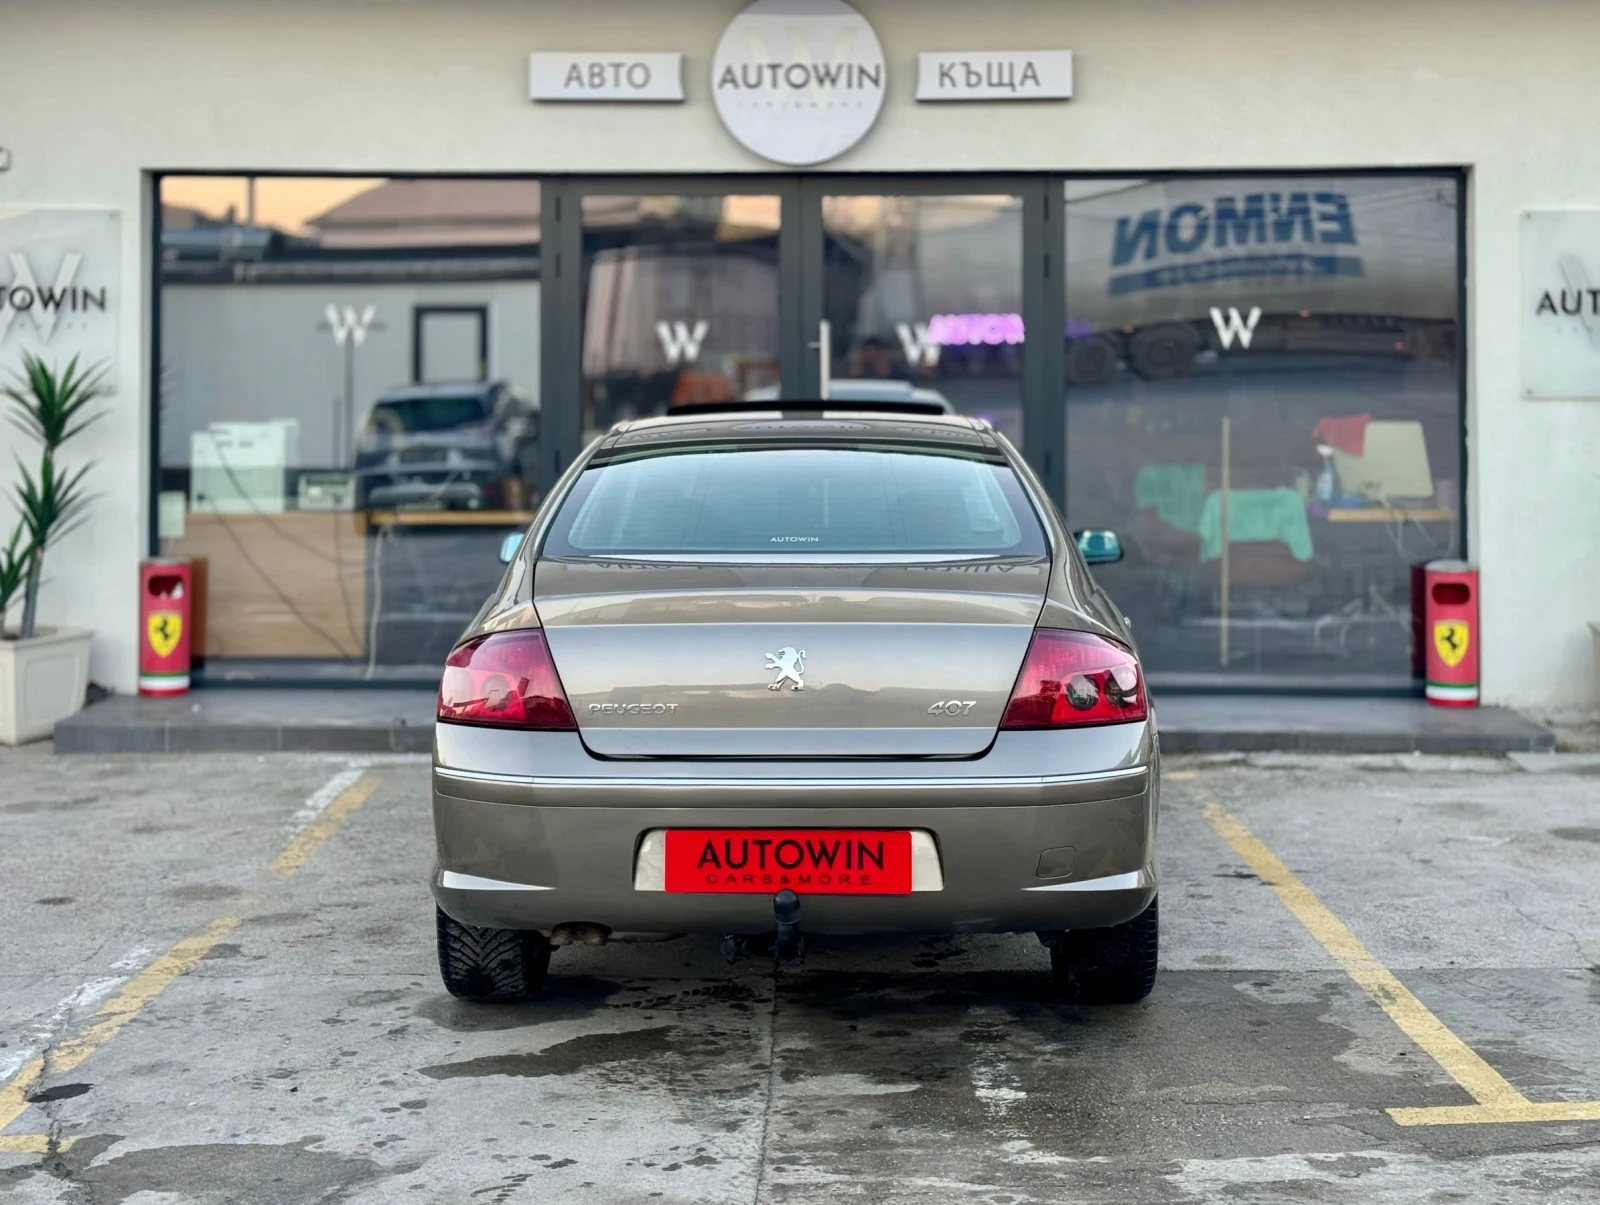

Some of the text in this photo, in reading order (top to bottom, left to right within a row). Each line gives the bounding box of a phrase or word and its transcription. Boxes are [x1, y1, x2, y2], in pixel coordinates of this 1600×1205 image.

[563, 63, 652, 89] АВТО
[717, 62, 882, 90] AUTOWIN
[937, 62, 1042, 94] КЪЩА
[324, 303, 377, 348] W
[1209, 306, 1263, 350] W
[656, 319, 710, 364] W
[769, 536, 820, 544] AUTOWIN
[588, 703, 680, 716] PEUGEOT
[927, 700, 979, 717] 407
[696, 839, 885, 871] AUTOWIN
